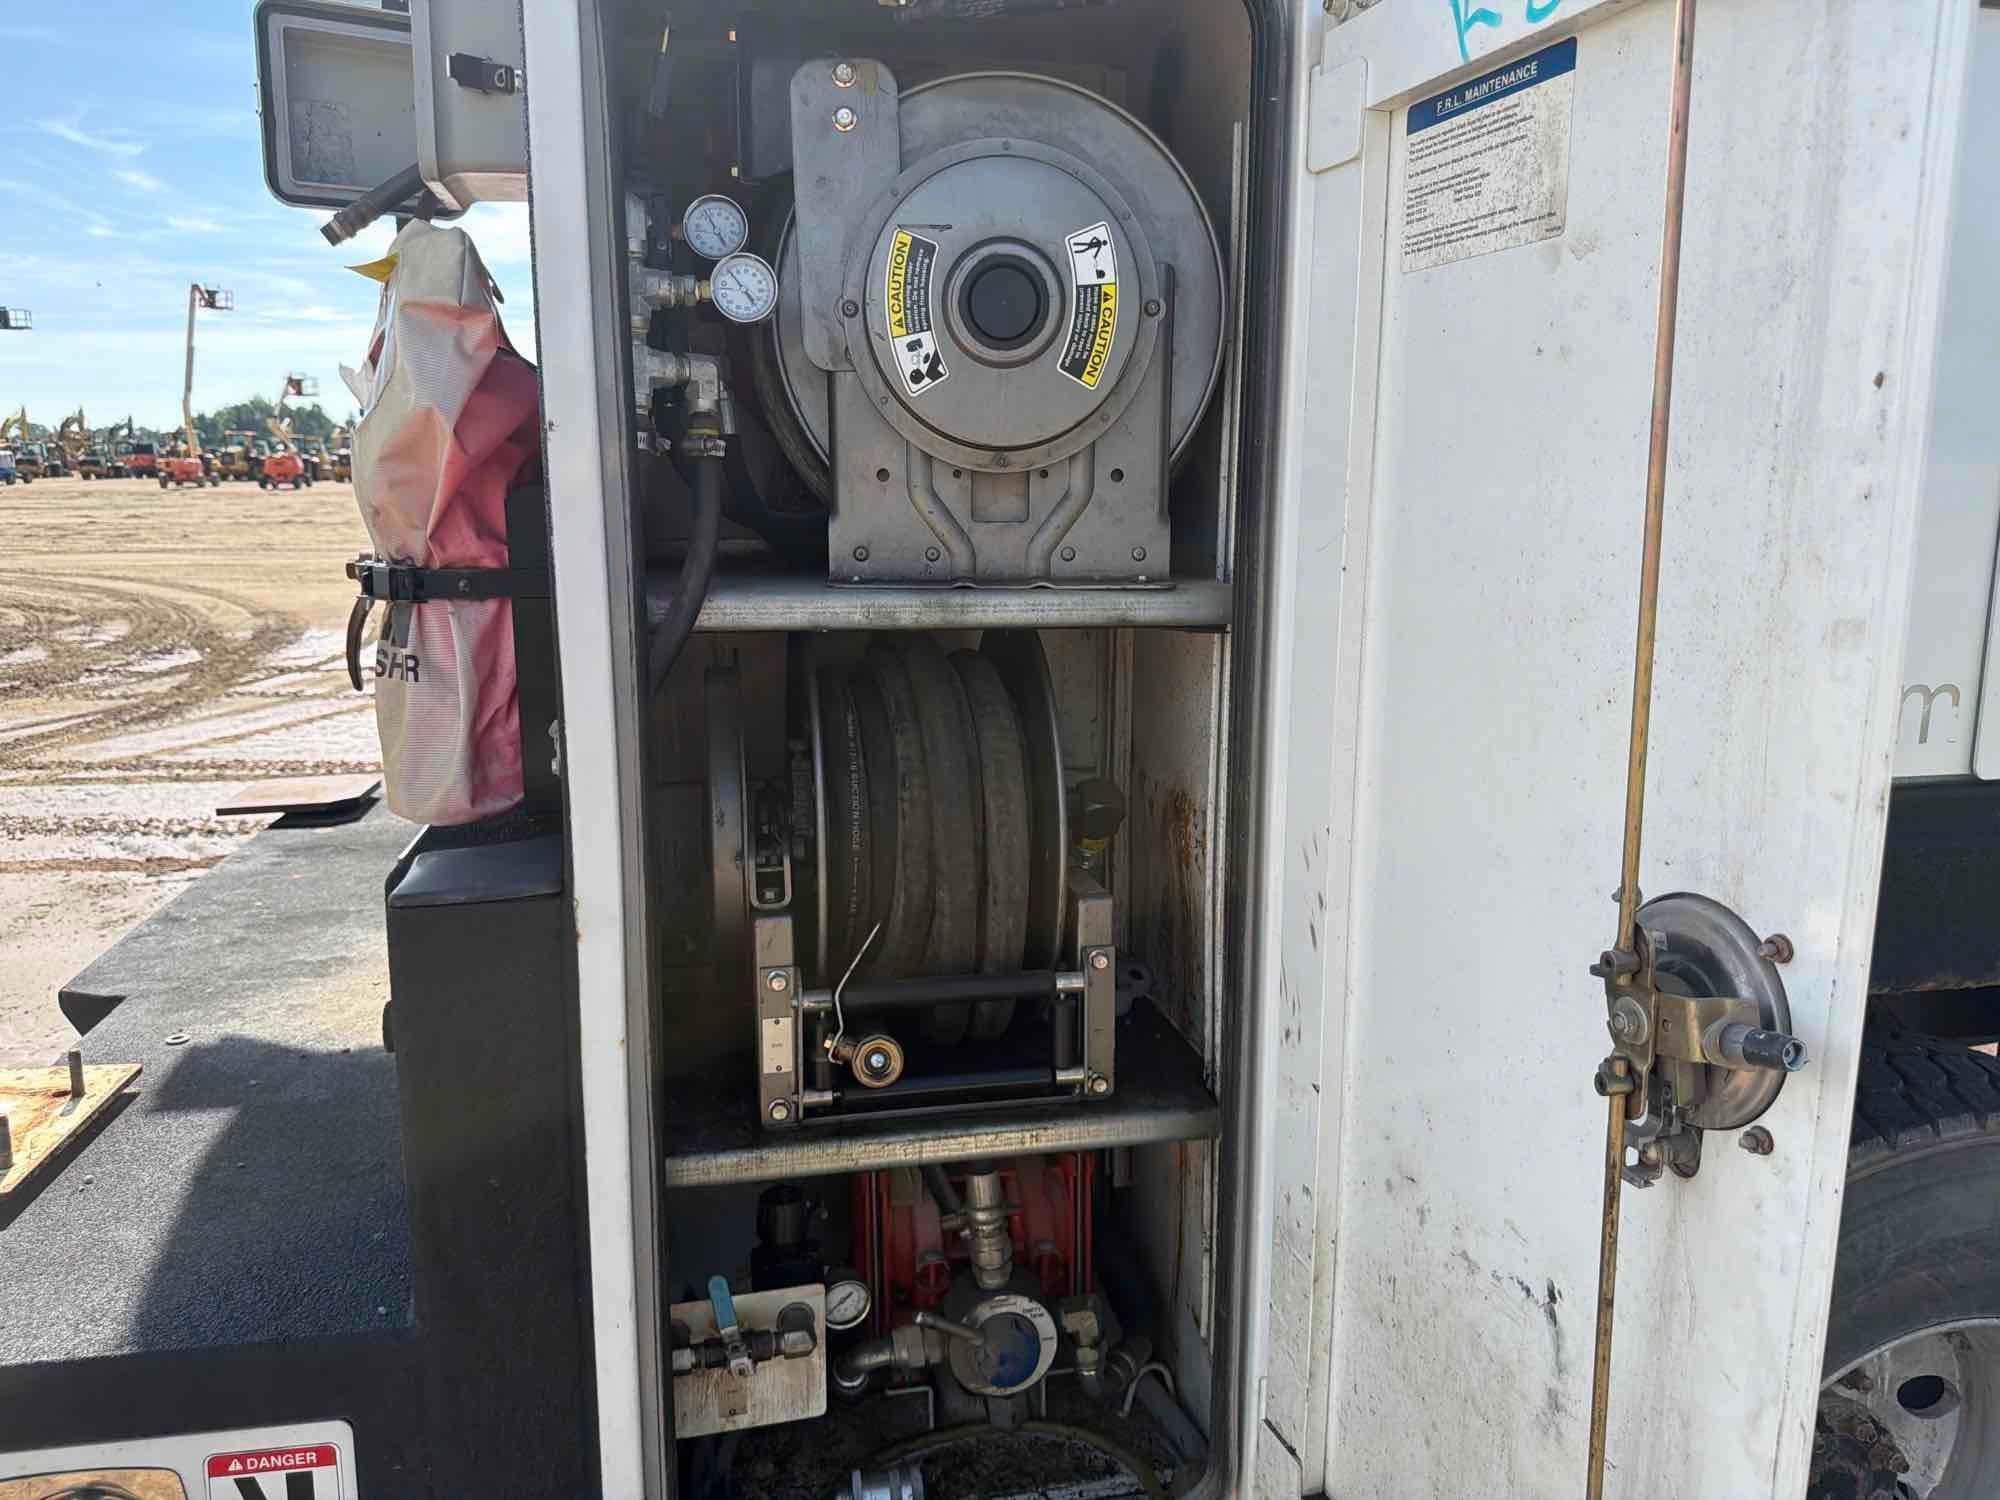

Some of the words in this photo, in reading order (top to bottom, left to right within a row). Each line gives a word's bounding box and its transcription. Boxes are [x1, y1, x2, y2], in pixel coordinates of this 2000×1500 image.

[1436, 96, 1462, 114] F.R.L.
[1464, 60, 1538, 102] MAINTENANCE
[891, 241, 907, 314] CAUTION
[1087, 307, 1113, 377] CAUTION
[246, 1452, 318, 1470] DANGER
